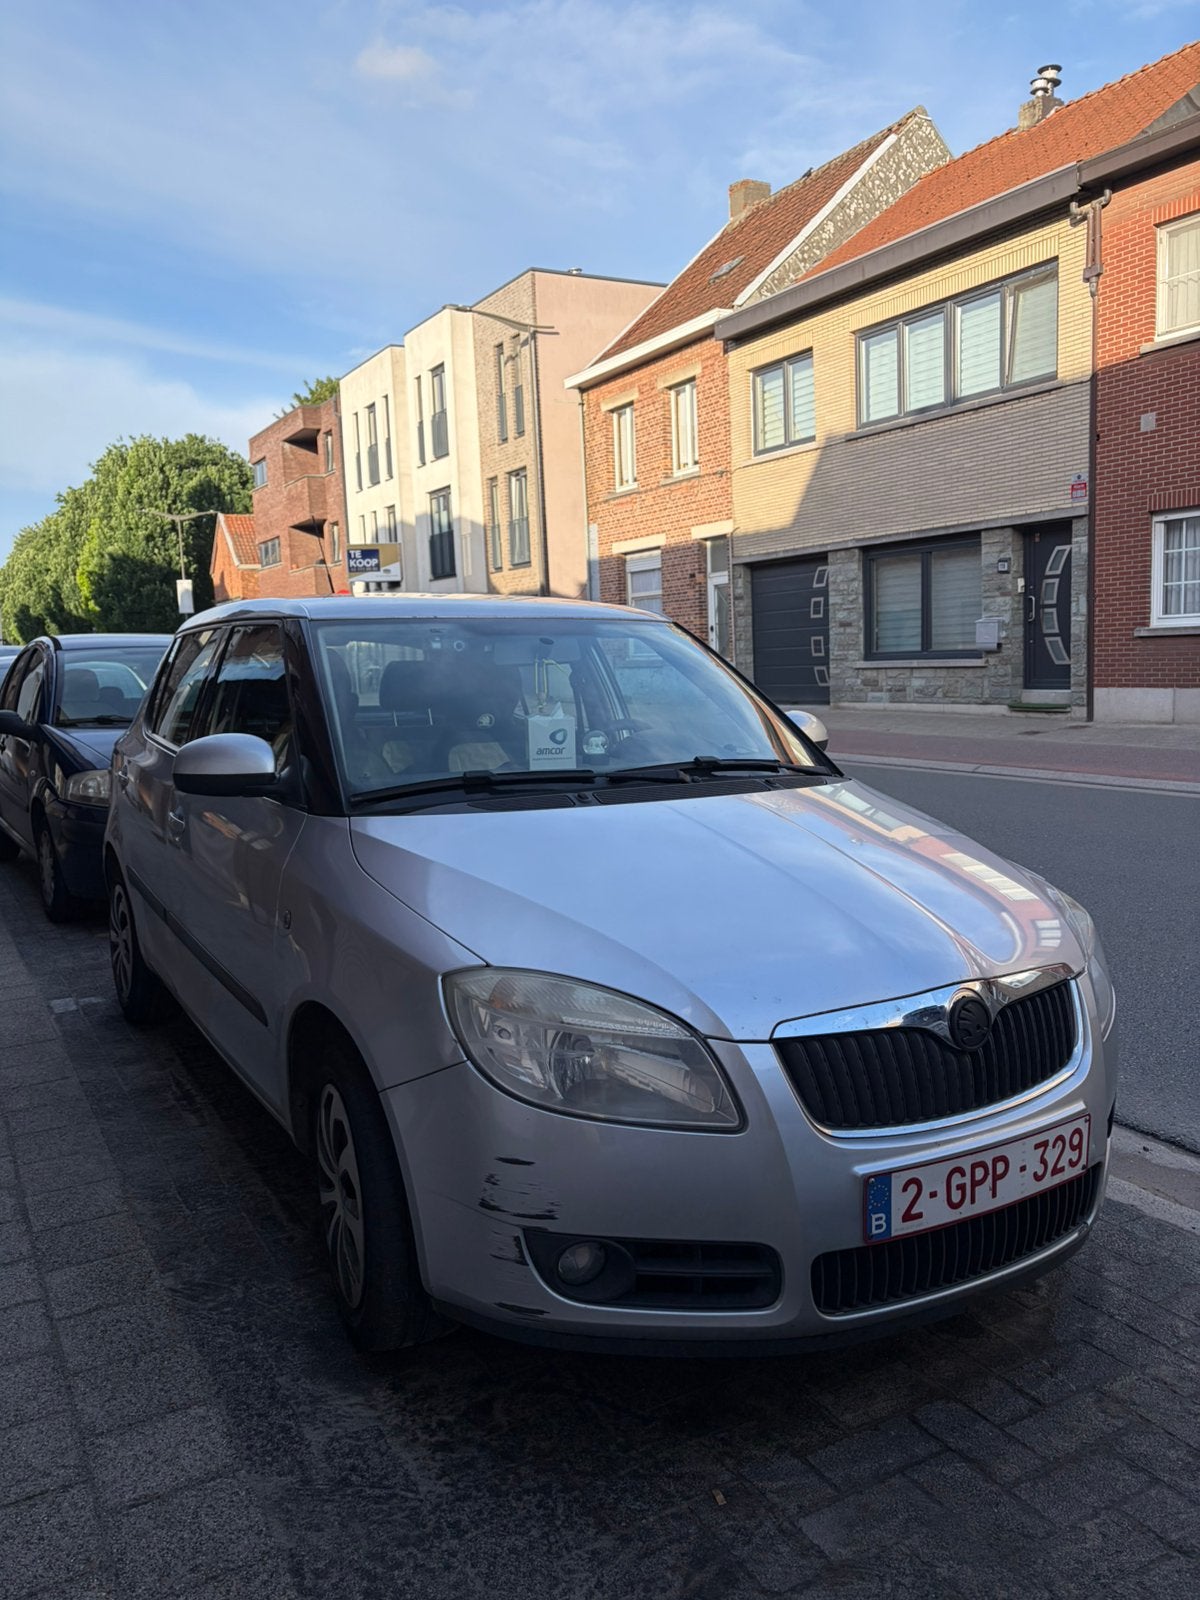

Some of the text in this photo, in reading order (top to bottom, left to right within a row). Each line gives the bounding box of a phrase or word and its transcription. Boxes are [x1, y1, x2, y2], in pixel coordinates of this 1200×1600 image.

[349, 550, 362, 558] TE
[349, 559, 378, 567] KOOP
[536, 747, 565, 755] amcor
[871, 1213, 887, 1235] B
